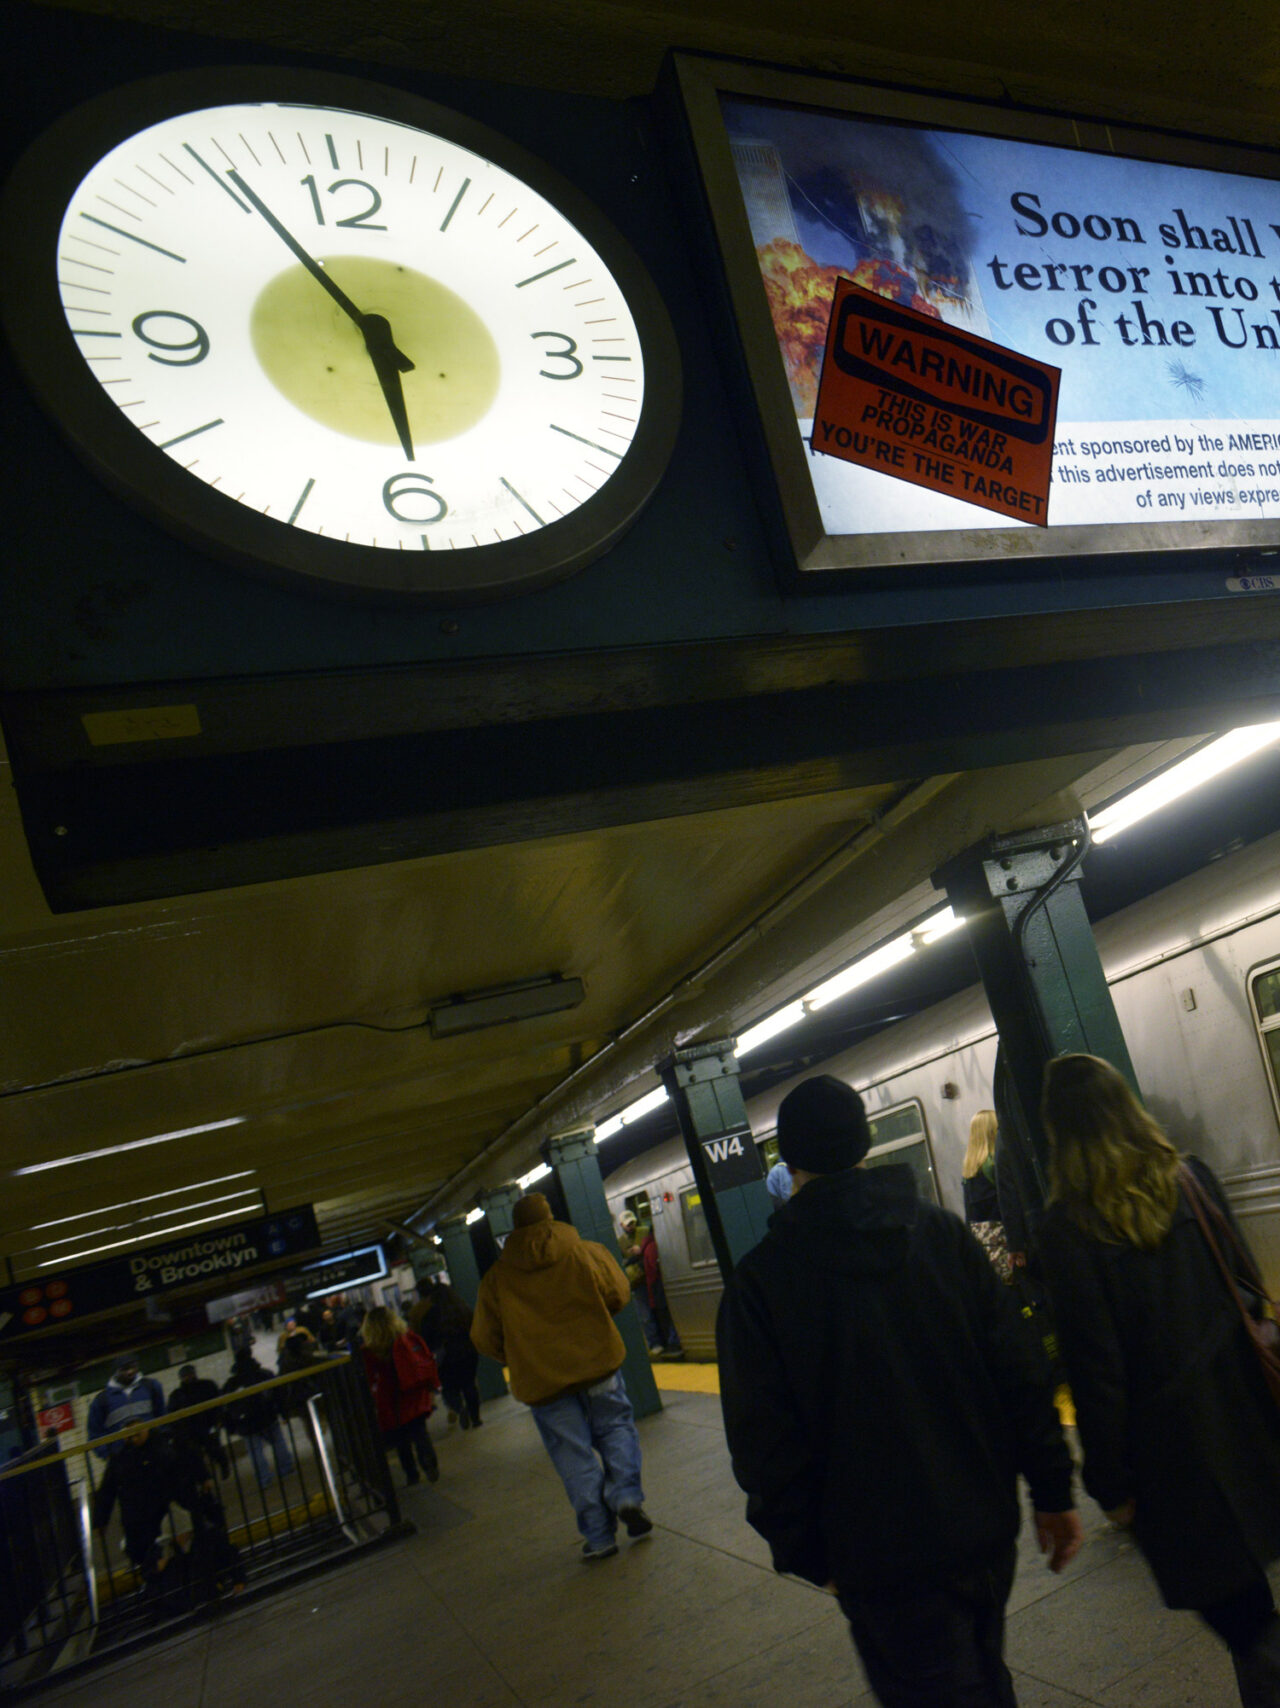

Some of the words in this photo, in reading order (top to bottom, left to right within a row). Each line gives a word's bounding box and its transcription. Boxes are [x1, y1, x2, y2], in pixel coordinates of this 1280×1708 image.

[300, 175, 388, 230] 12
[1010, 191, 1147, 244] Soon
[1158, 208, 1266, 259] shall
[987, 255, 1151, 293] terror
[1164, 254, 1259, 301] into
[132, 311, 210, 366] 9
[1045, 298, 1101, 346] of
[1114, 300, 1196, 347] the
[530, 332, 584, 381] 3
[858, 322, 1037, 418] WARNING
[860, 405, 1014, 475] PROPAGANDA
[877, 389, 926, 423] THIS
[930, 411, 952, 432] IS
[959, 420, 1008, 452] WAR
[821, 420, 906, 468] YOU'RE
[912, 452, 955, 485] THE
[961, 469, 1045, 515] TARGET
[1080, 435, 1172, 459] sponsored
[1174, 435, 1195, 456] by
[1197, 435, 1224, 451] the
[1058, 465, 1091, 484] this
[1095, 461, 1215, 483] advertisement
[1218, 460, 1255, 478] does
[382, 472, 448, 526] 6
[1135, 489, 1153, 508] of
[1157, 491, 1186, 510] any
[1190, 488, 1236, 506] views
[704, 1136, 745, 1164] W4
[129, 1231, 248, 1275] Downtown
[134, 1273, 154, 1292] &
[160, 1245, 258, 1285] Brooklyn
